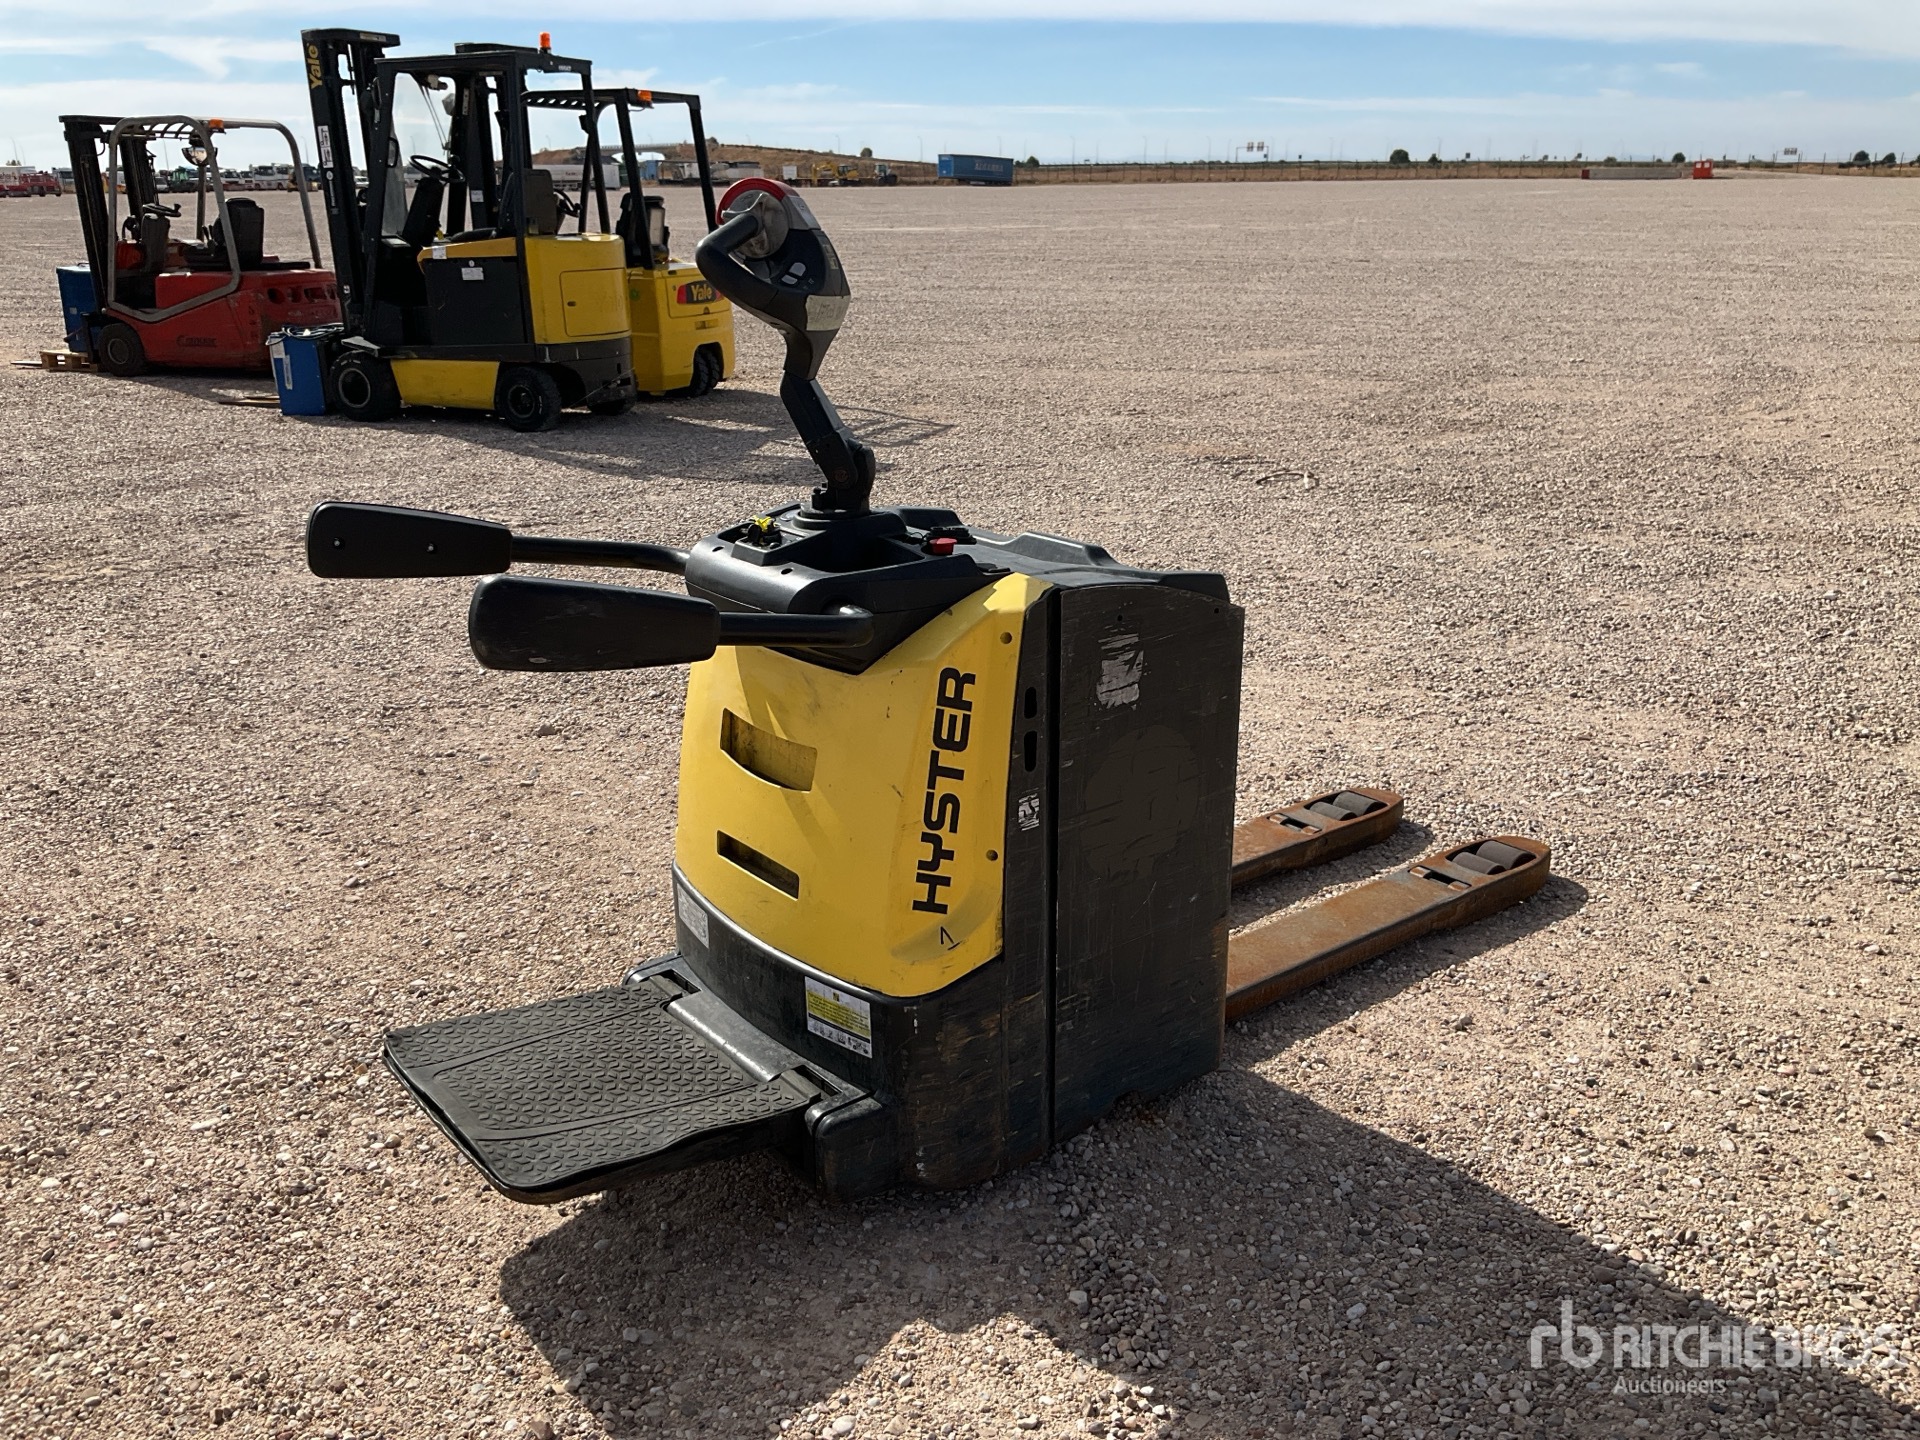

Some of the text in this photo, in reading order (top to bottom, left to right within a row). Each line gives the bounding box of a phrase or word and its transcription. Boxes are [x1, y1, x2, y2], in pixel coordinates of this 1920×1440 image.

[307, 45, 323, 89] Yale
[690, 284, 713, 301] Yale
[912, 667, 976, 915] HYSTER
